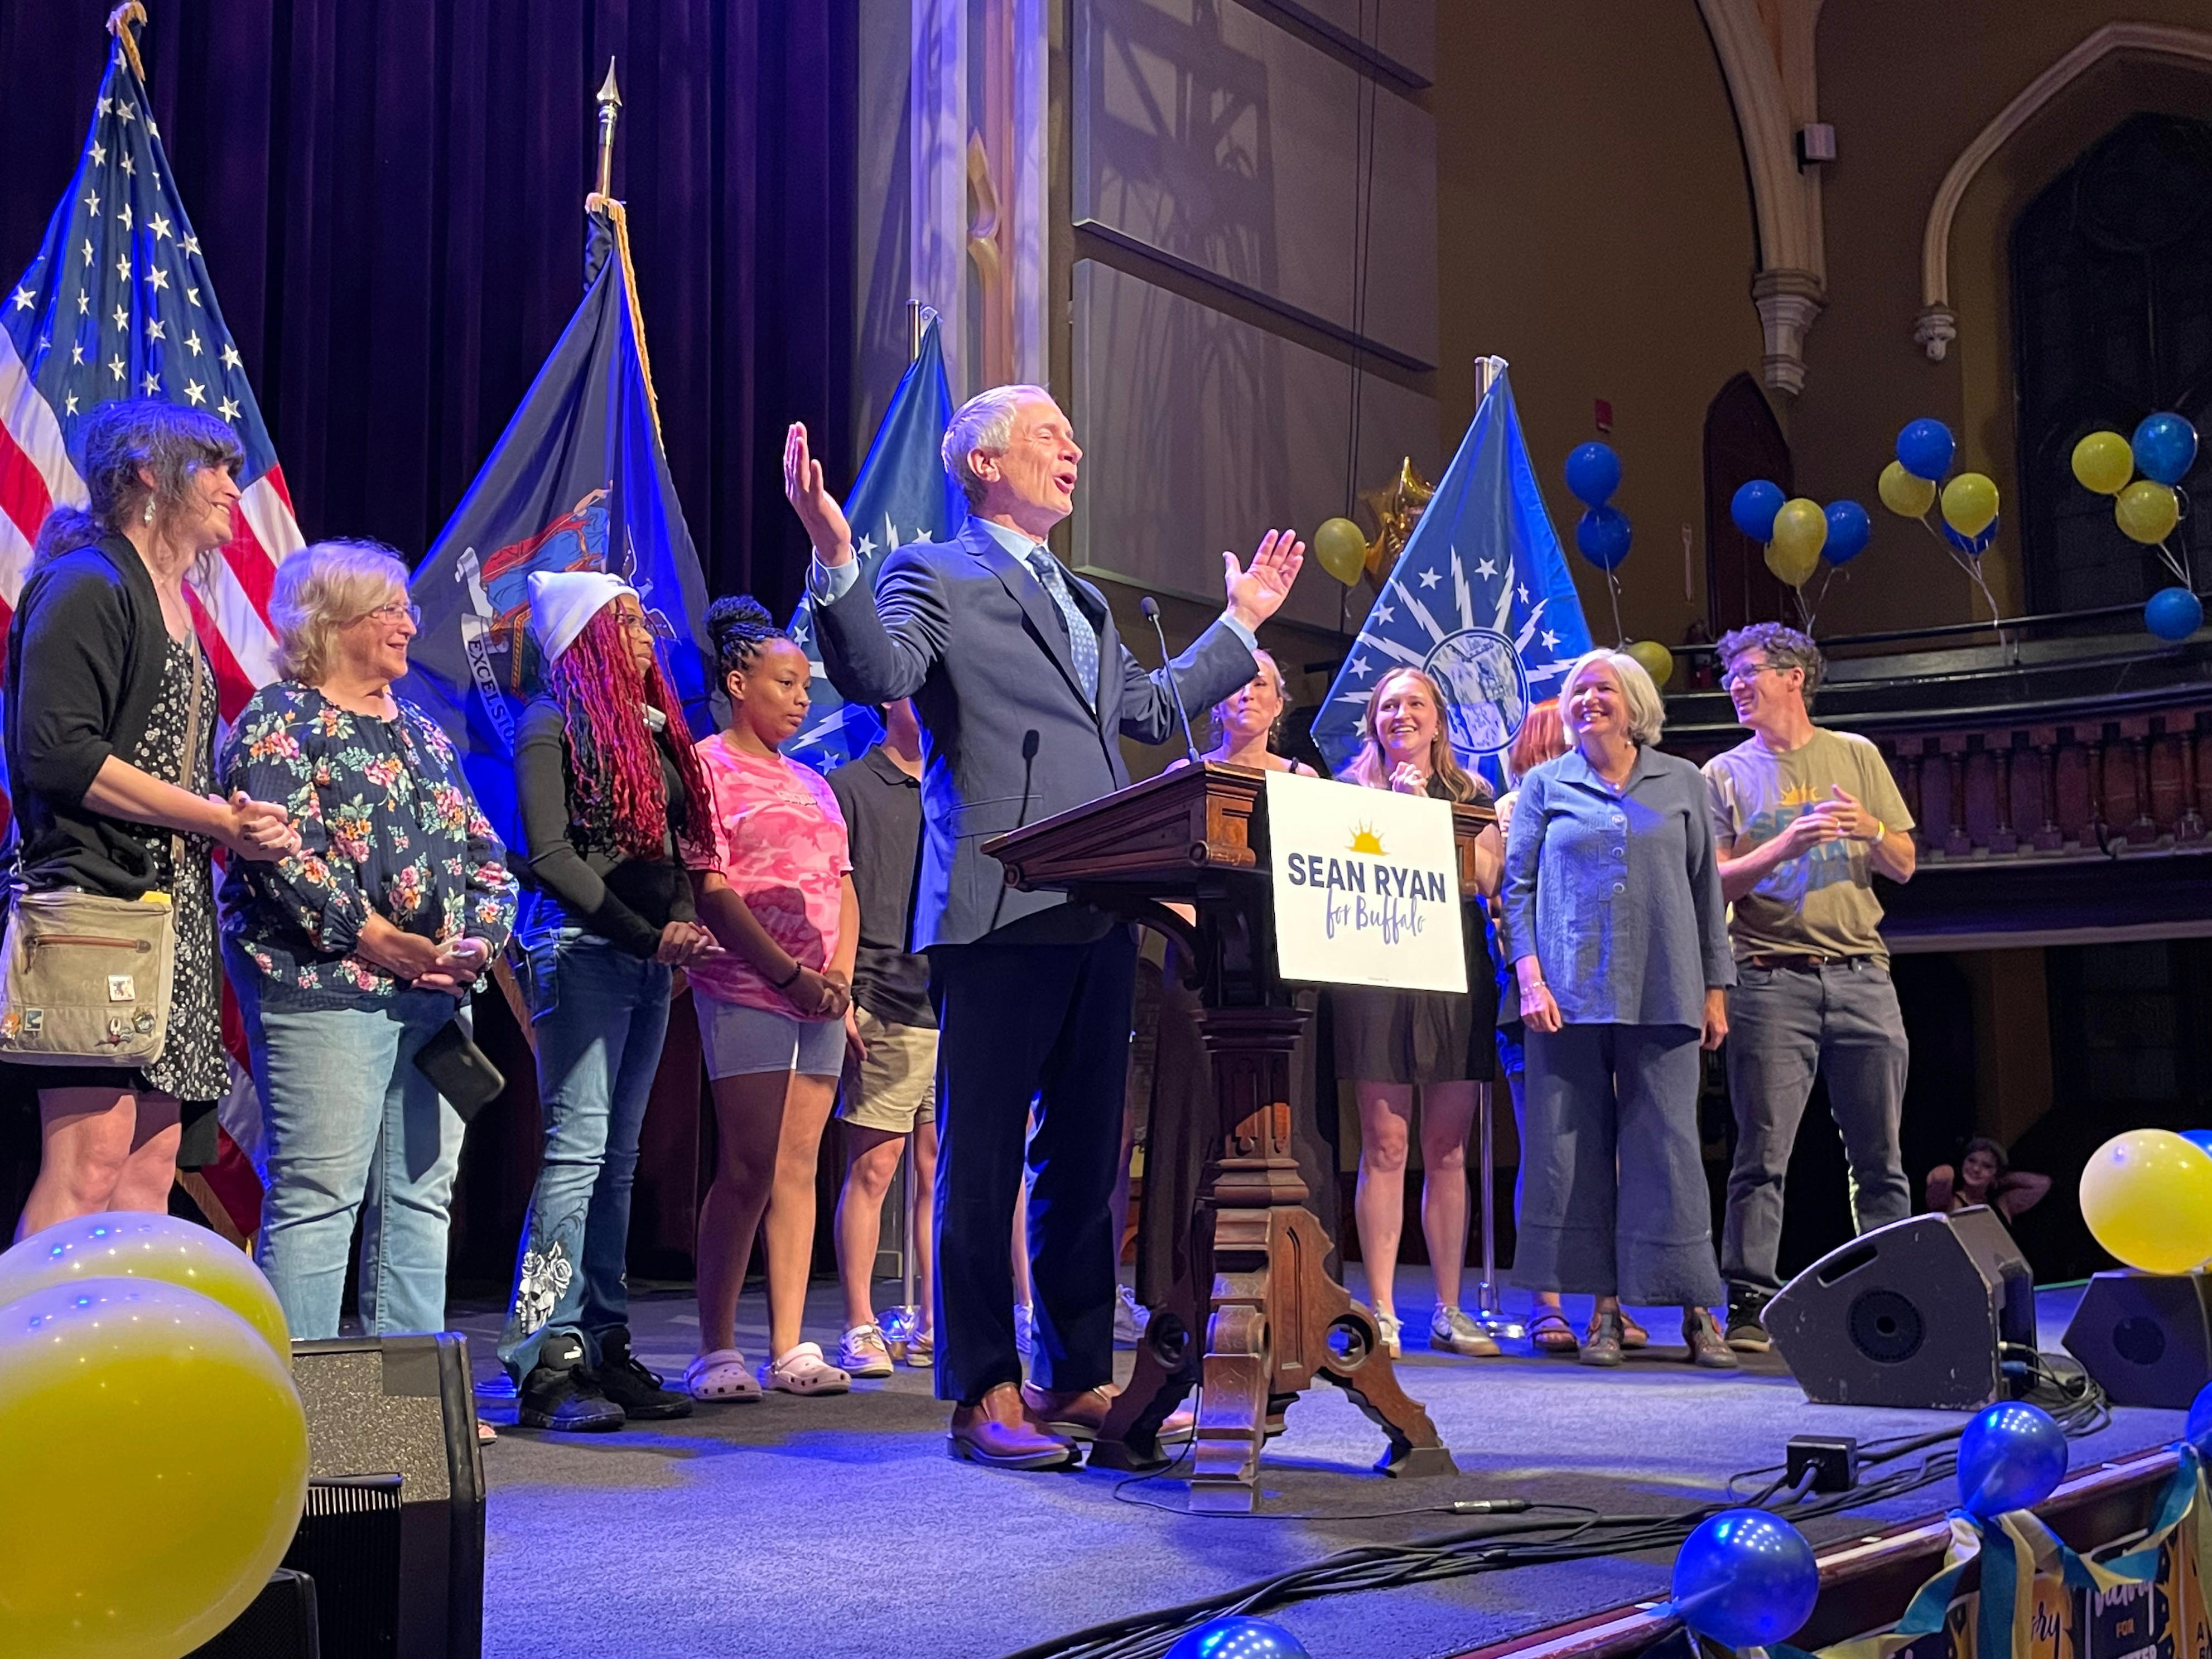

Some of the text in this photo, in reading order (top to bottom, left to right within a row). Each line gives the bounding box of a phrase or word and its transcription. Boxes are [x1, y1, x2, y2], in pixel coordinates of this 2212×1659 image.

[469, 640, 514, 744] EXCELSIO
[1288, 853, 1446, 903] SEAN RYAN
[1326, 885, 1426, 945] for Buffalo
